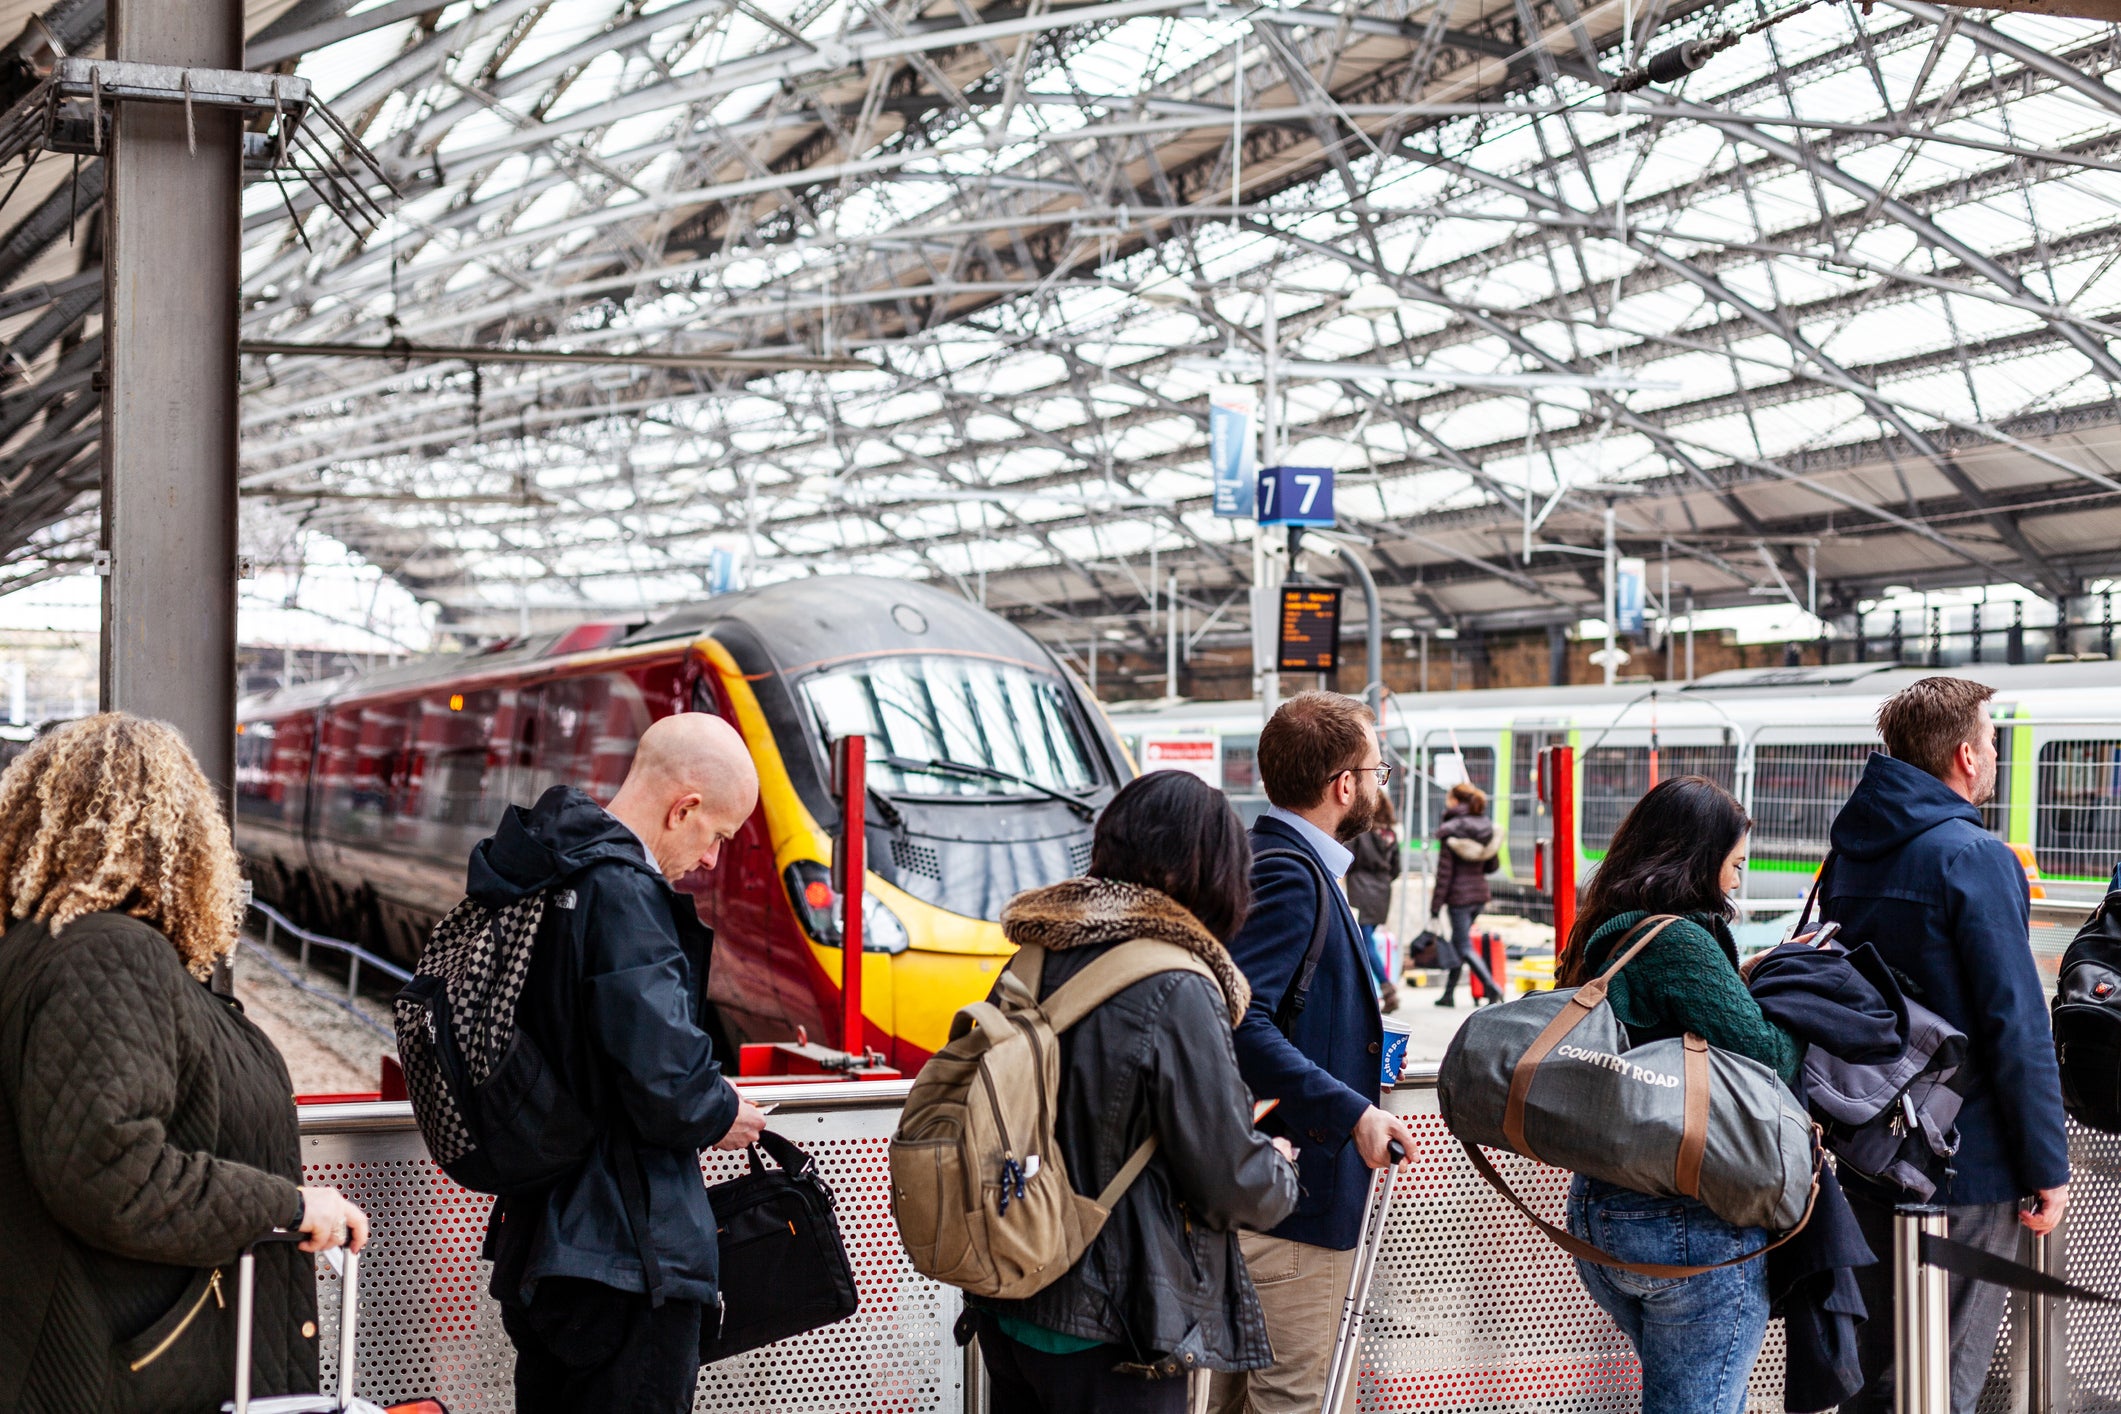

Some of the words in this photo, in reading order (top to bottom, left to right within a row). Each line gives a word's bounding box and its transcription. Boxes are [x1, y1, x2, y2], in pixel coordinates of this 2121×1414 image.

[1262, 476, 1276, 516] 7
[1294, 474, 1321, 515] 7
[1557, 1044, 1632, 1076] COUNTRY
[1632, 1065, 1680, 1088] ROAD
